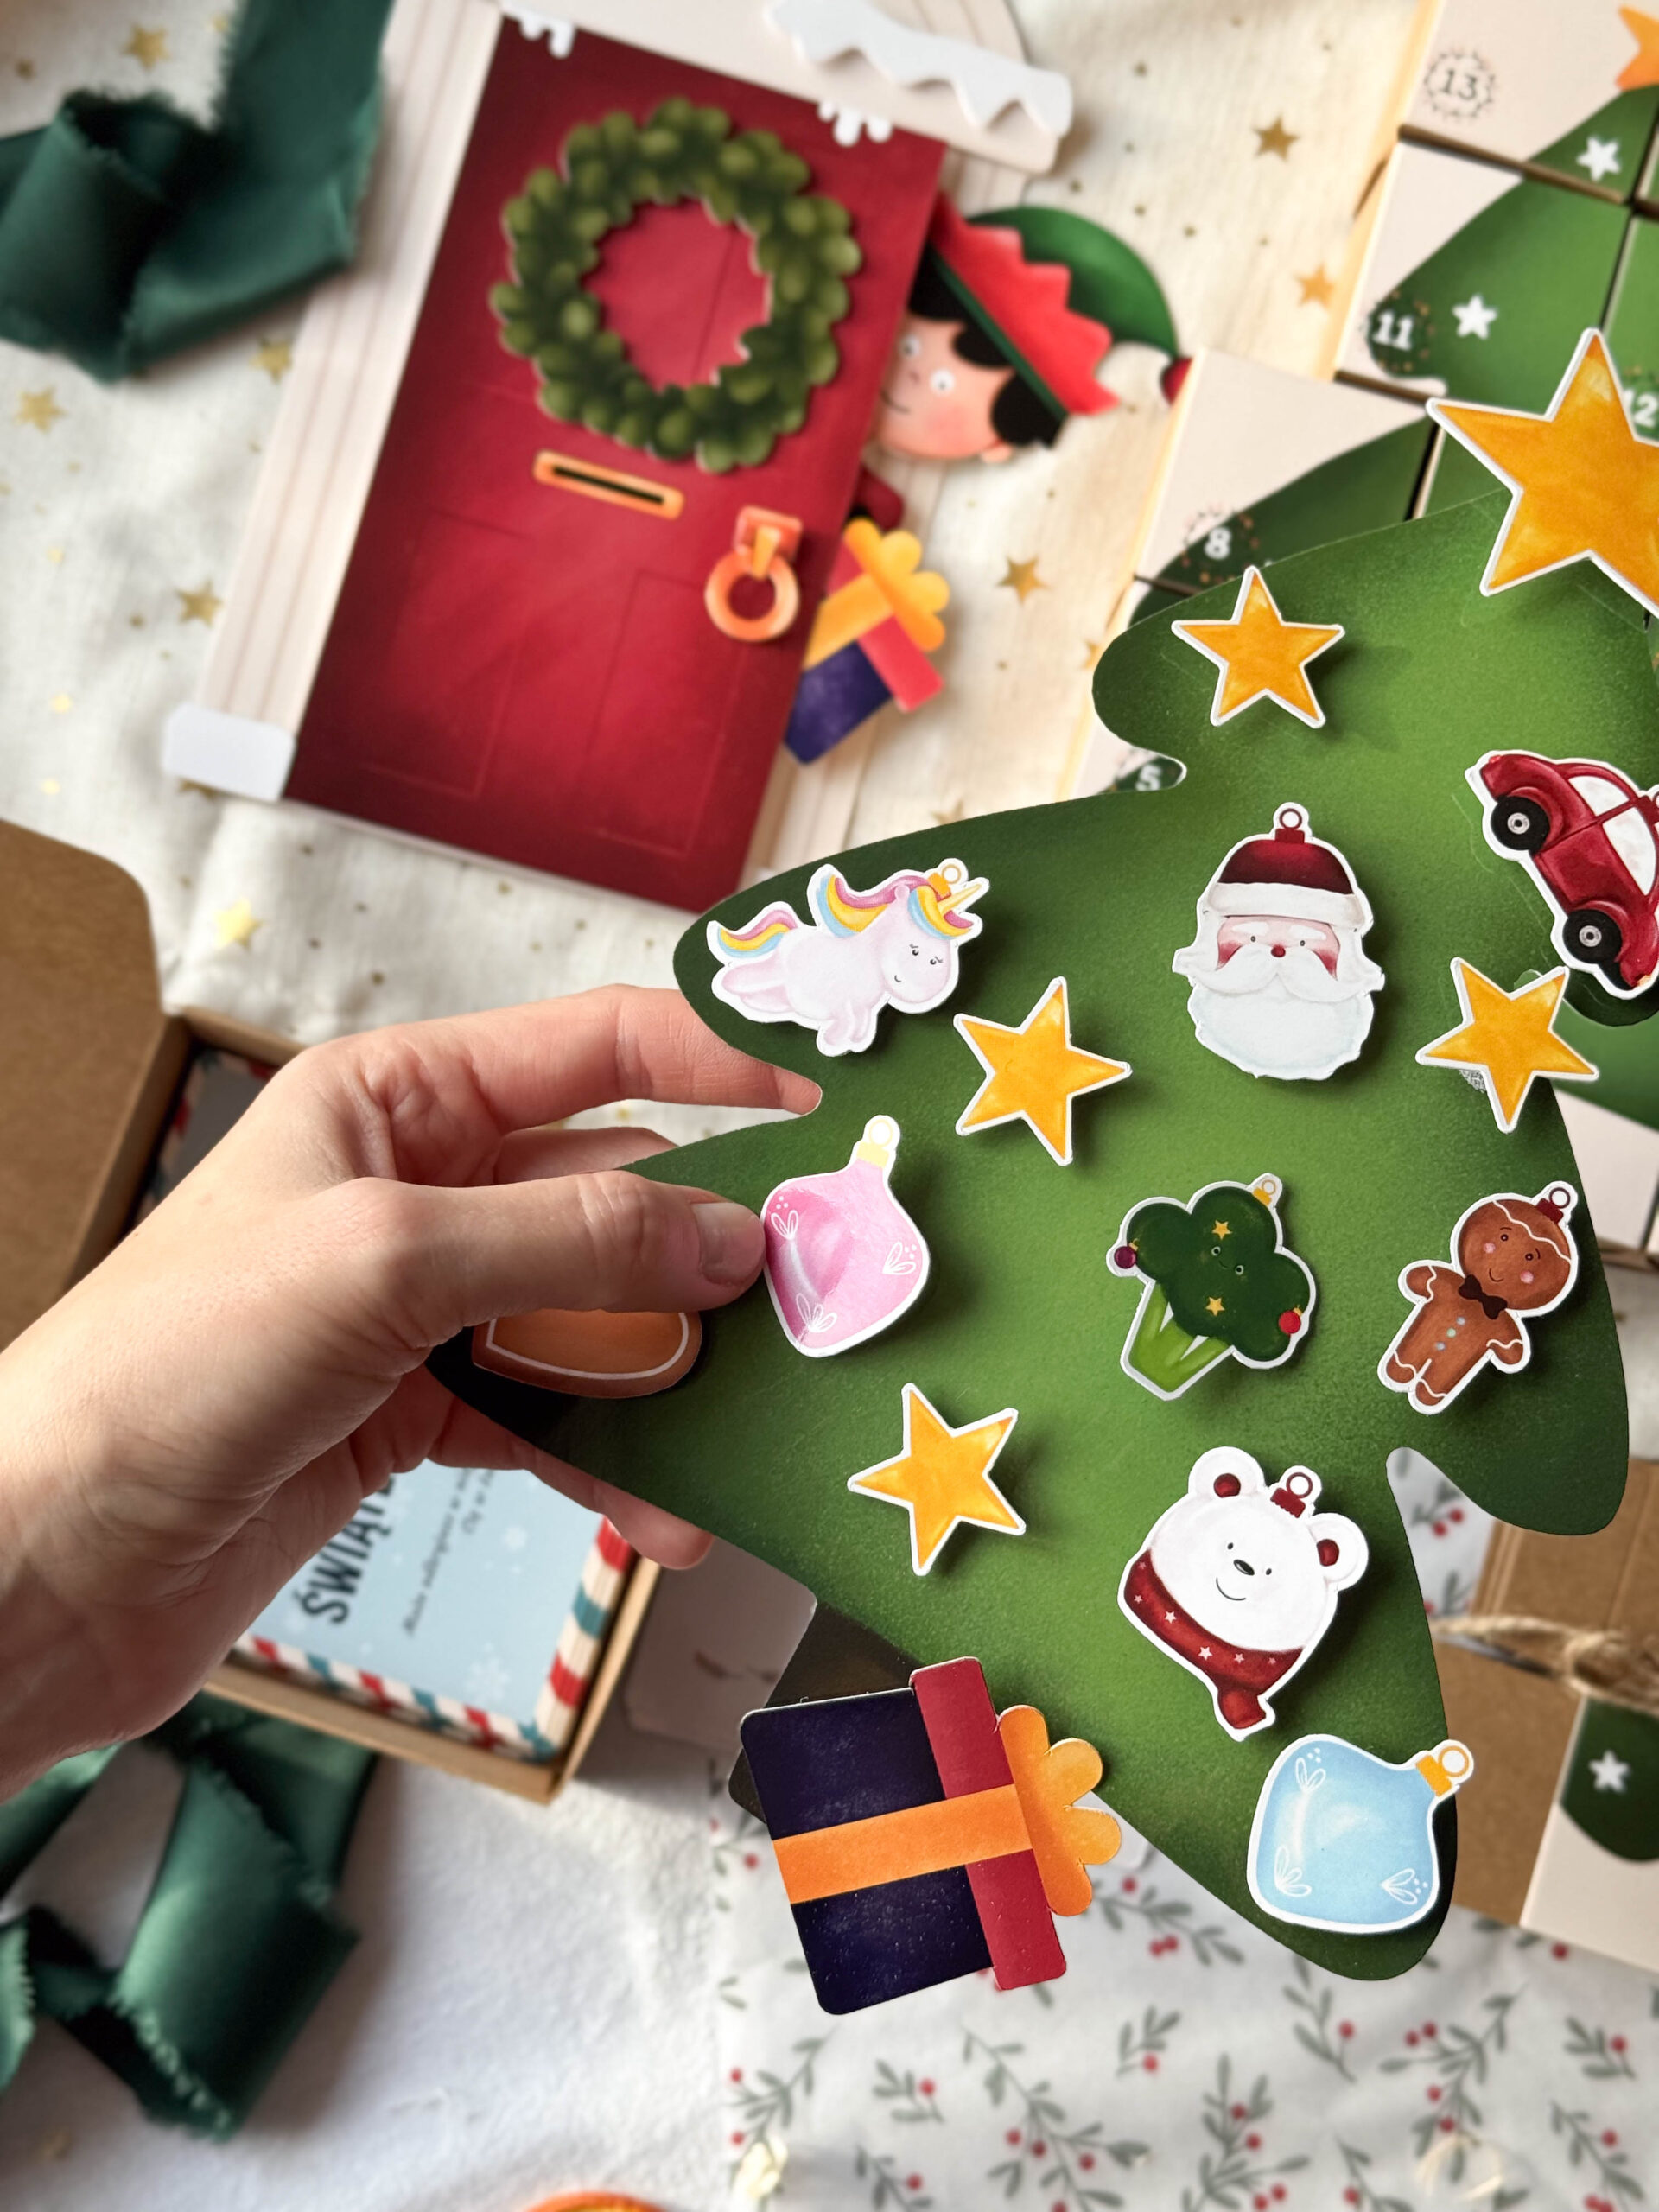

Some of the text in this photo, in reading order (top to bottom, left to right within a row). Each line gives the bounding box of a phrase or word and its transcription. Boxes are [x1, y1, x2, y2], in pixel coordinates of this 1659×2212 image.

[1441, 69, 1478, 101] 13
[1373, 310, 1414, 351] 11
[1205, 527, 1231, 559] 8
[1135, 763, 1162, 791] 5
